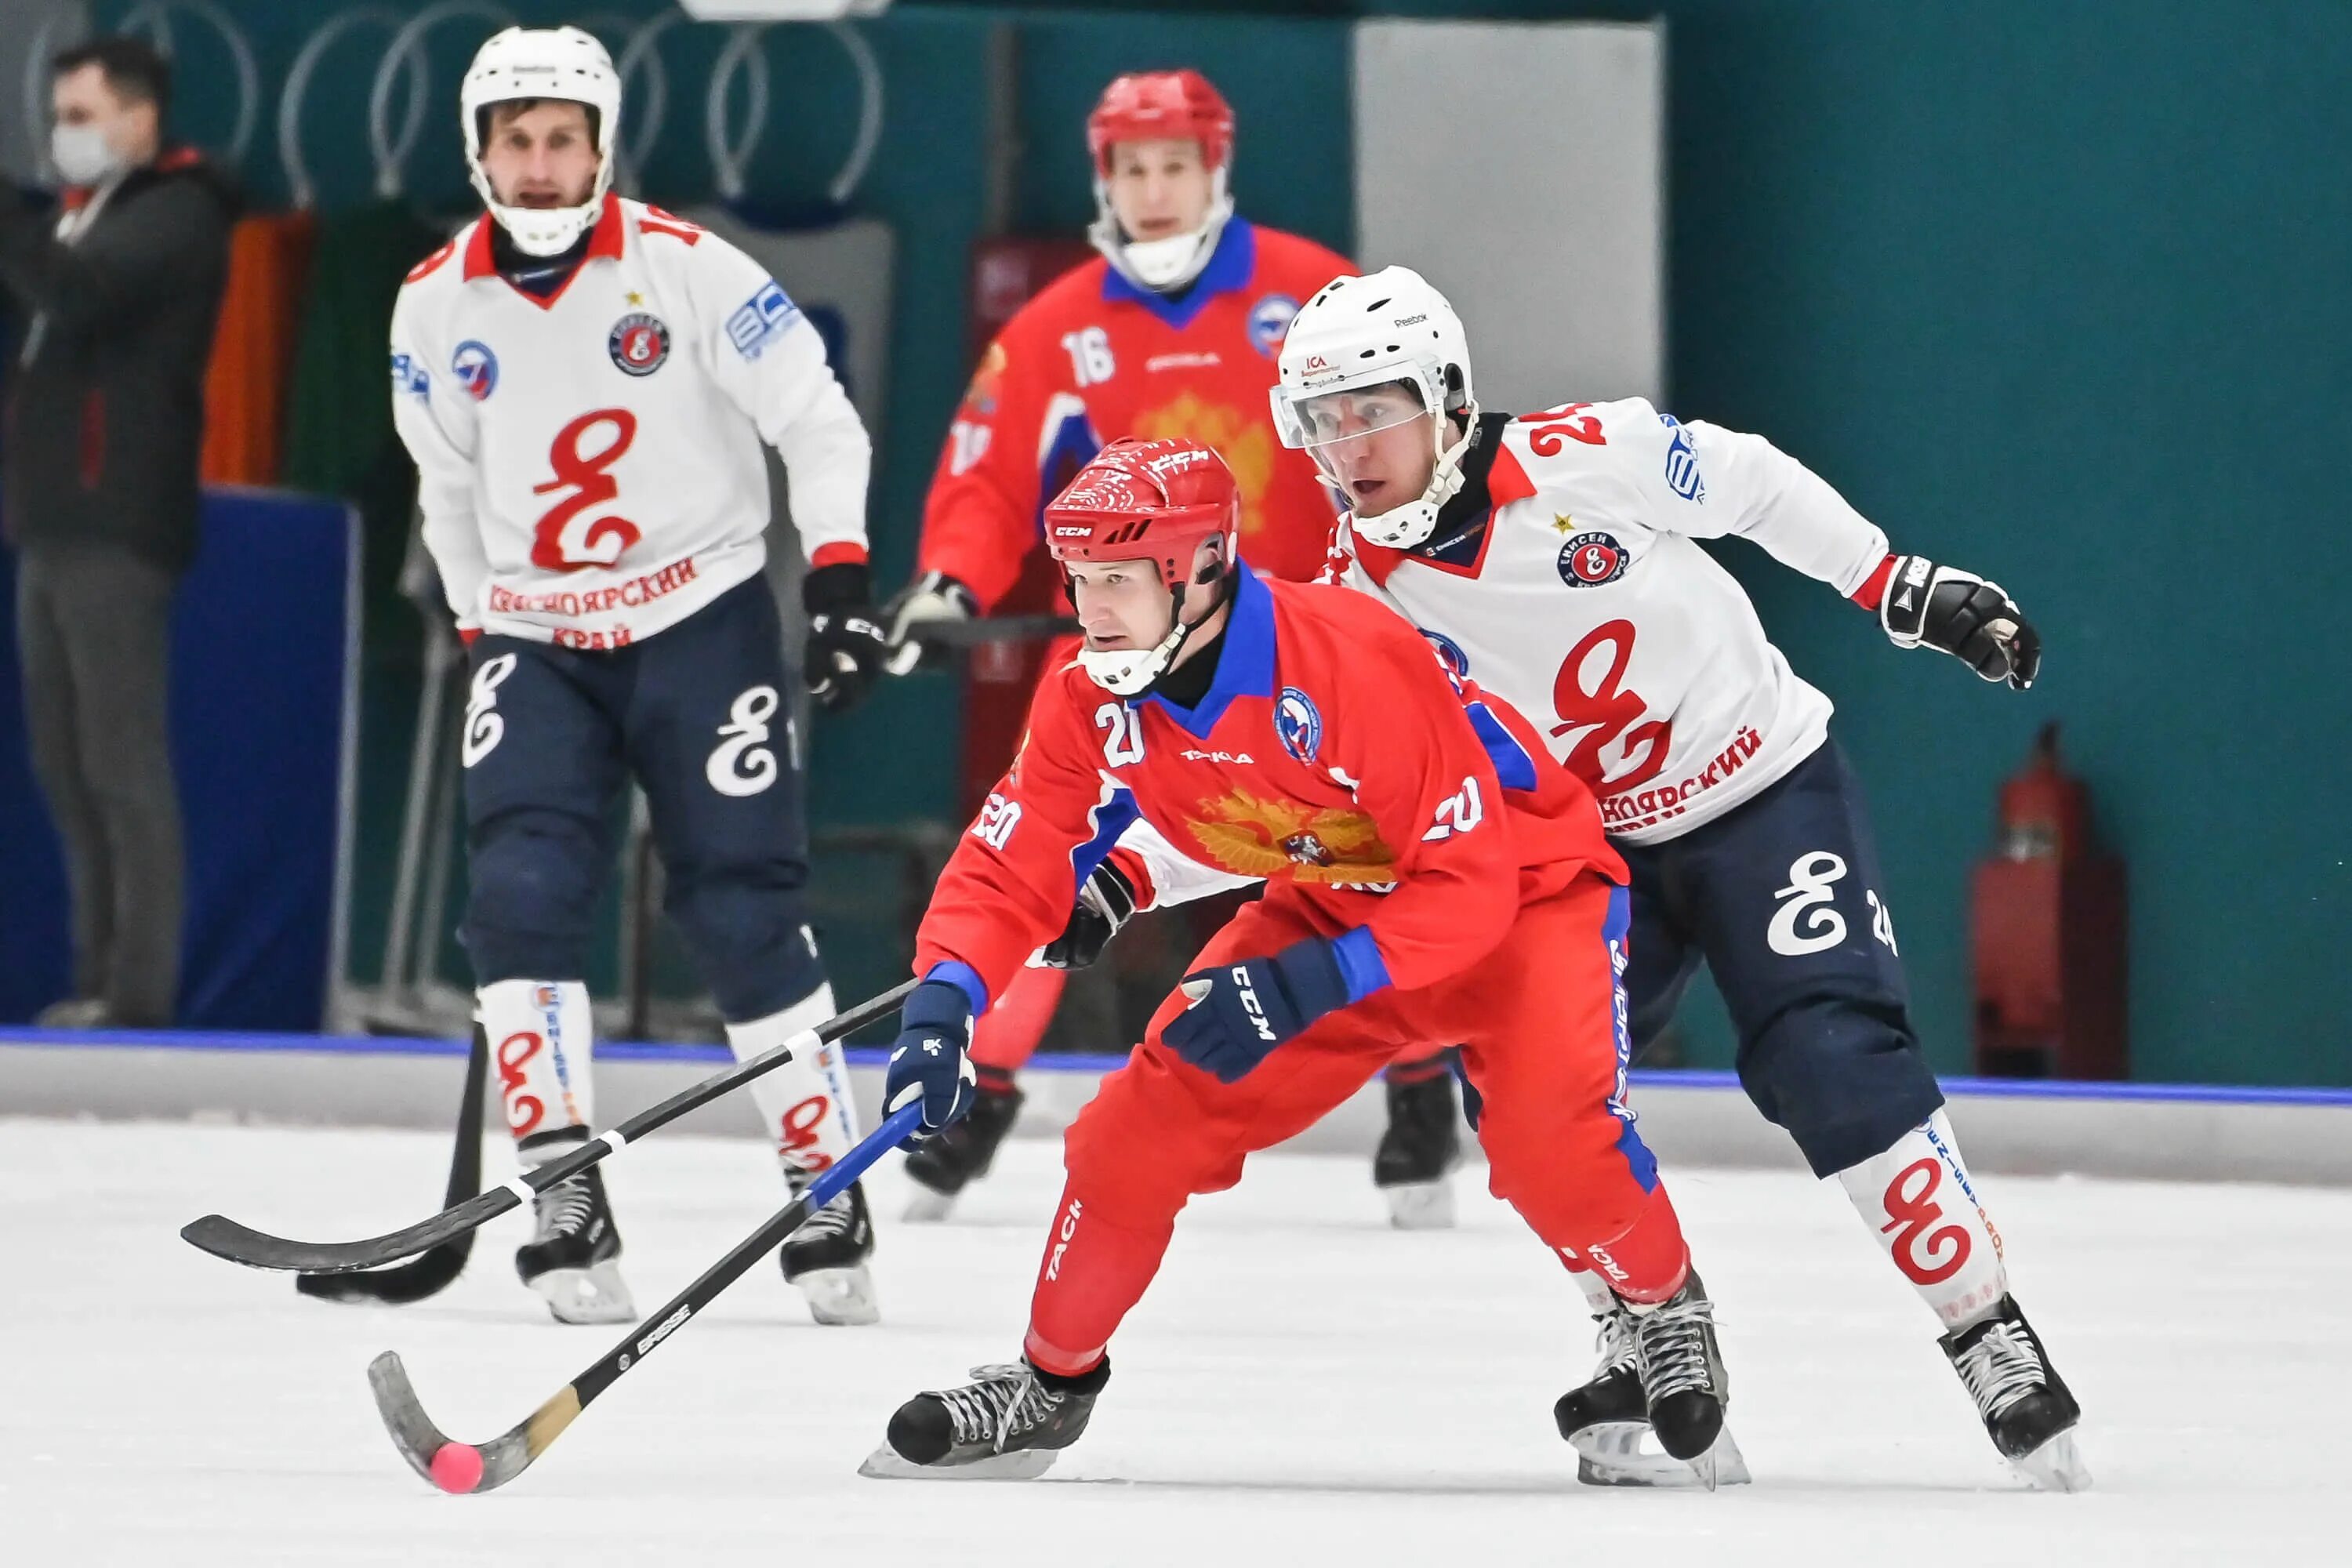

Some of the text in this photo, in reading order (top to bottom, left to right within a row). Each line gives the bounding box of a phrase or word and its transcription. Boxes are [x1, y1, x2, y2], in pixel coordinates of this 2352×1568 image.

[1394, 314, 1428, 328] Reebok
[1061, 326, 1116, 387] 16
[1306, 355, 1327, 369] ICA
[1151, 450, 1209, 471] CCM
[1055, 527, 1092, 537] CCM
[1232, 965, 1276, 1041] CCM
